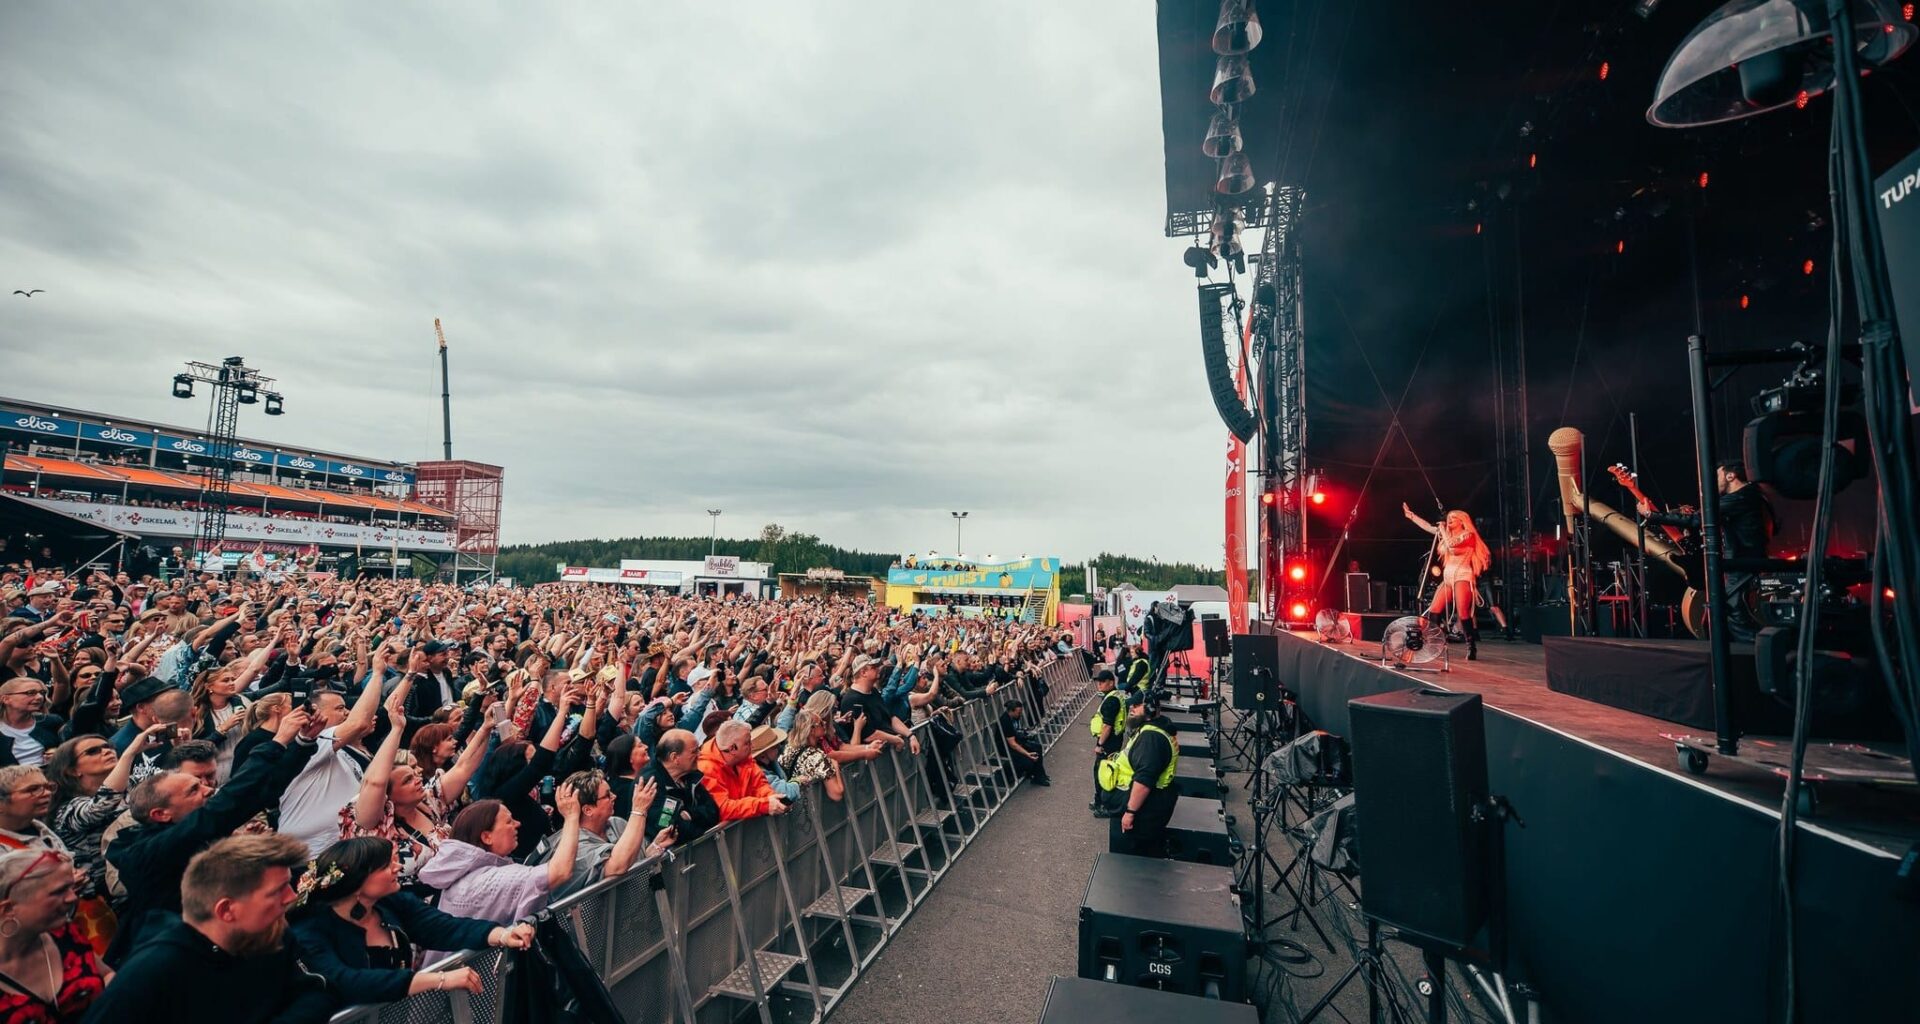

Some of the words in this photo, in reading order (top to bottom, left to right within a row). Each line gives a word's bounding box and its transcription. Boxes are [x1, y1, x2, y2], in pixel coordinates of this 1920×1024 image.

[15, 416, 59, 431] elisa
[98, 428, 137, 442] elisa
[172, 440, 205, 452] elisa
[233, 448, 263, 461] elisa
[289, 457, 316, 469] elisa
[340, 464, 364, 475] elisa
[384, 471, 406, 482] elisa
[142, 517, 177, 525] ISKELMÄ
[931, 567, 988, 587] TWIST
[1149, 962, 1172, 976] CGS
